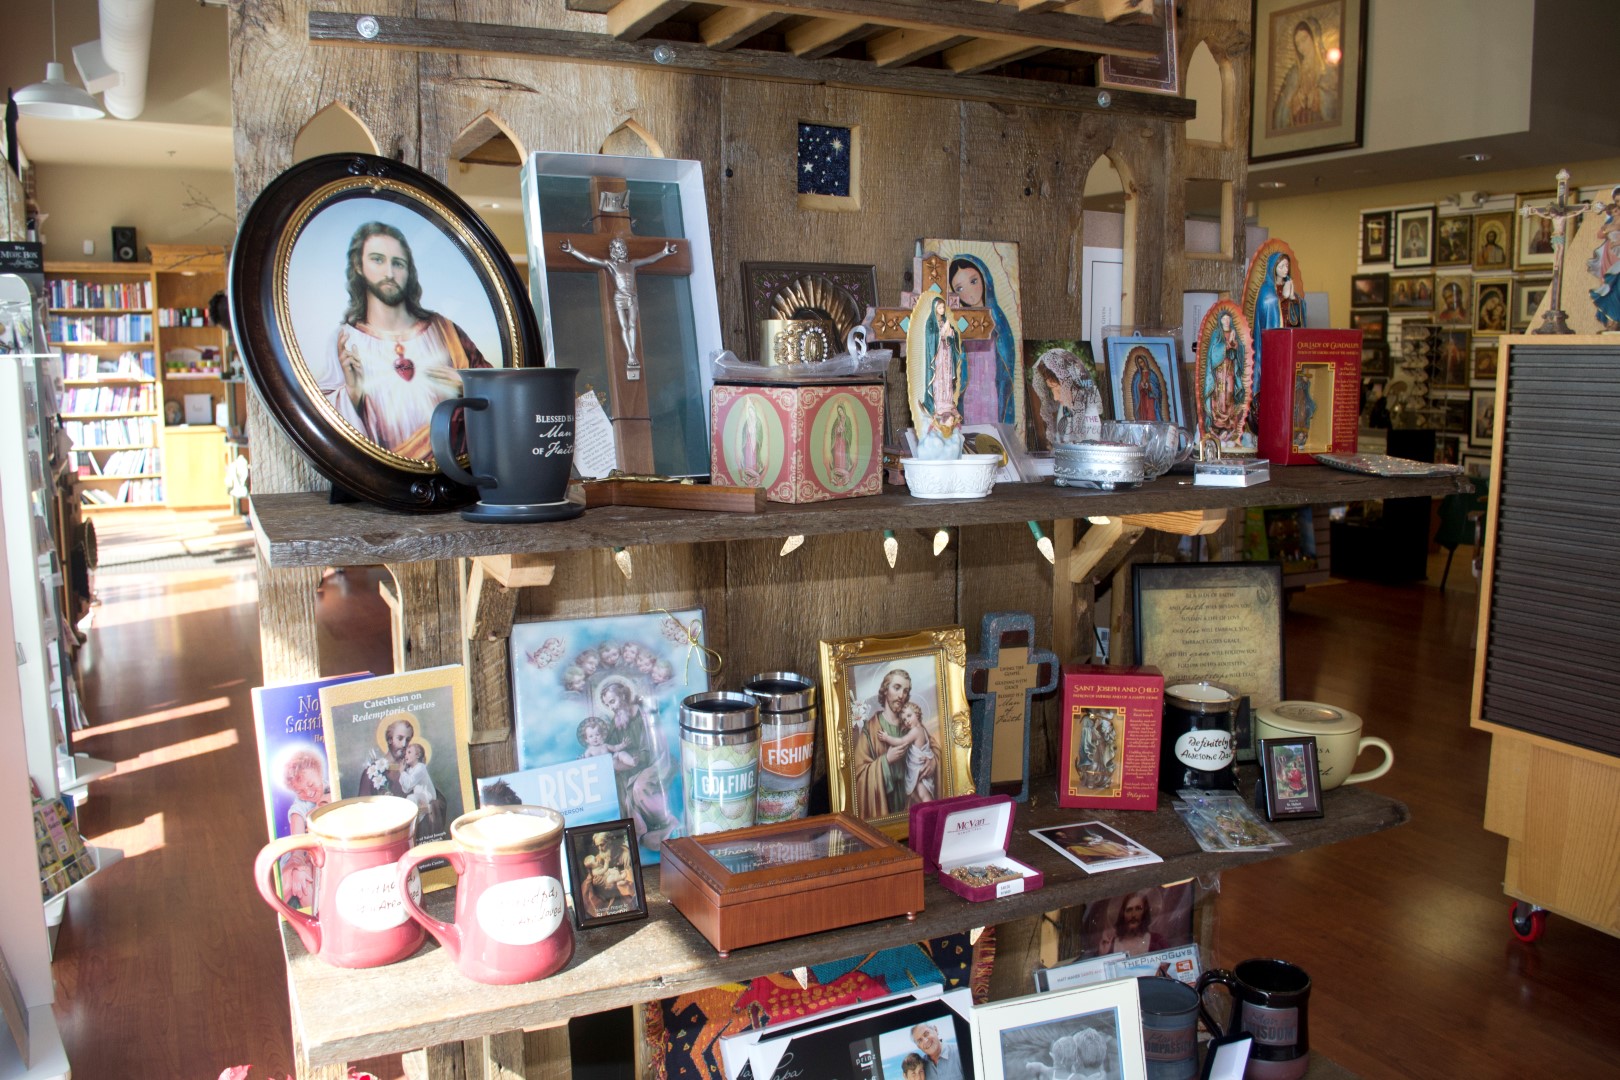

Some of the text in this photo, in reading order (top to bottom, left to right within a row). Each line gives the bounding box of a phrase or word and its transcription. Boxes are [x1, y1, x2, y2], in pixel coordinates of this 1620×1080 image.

[536, 414, 566, 423] BLESSED
[539, 423, 572, 438] Man
[532, 448, 544, 456] OF
[1073, 684, 1094, 692] SAINT
[1096, 685, 1120, 693] JOSEPH
[363, 692, 422, 709] Catechism on
[352, 700, 436, 724] Redemptoris Custos
[1188, 736, 1229, 752] Definitely
[1181, 750, 1217, 760] Awesome
[538, 763, 602, 812] RISE
[956, 818, 985, 830] McVan
[856, 1054, 876, 1066] prinz
